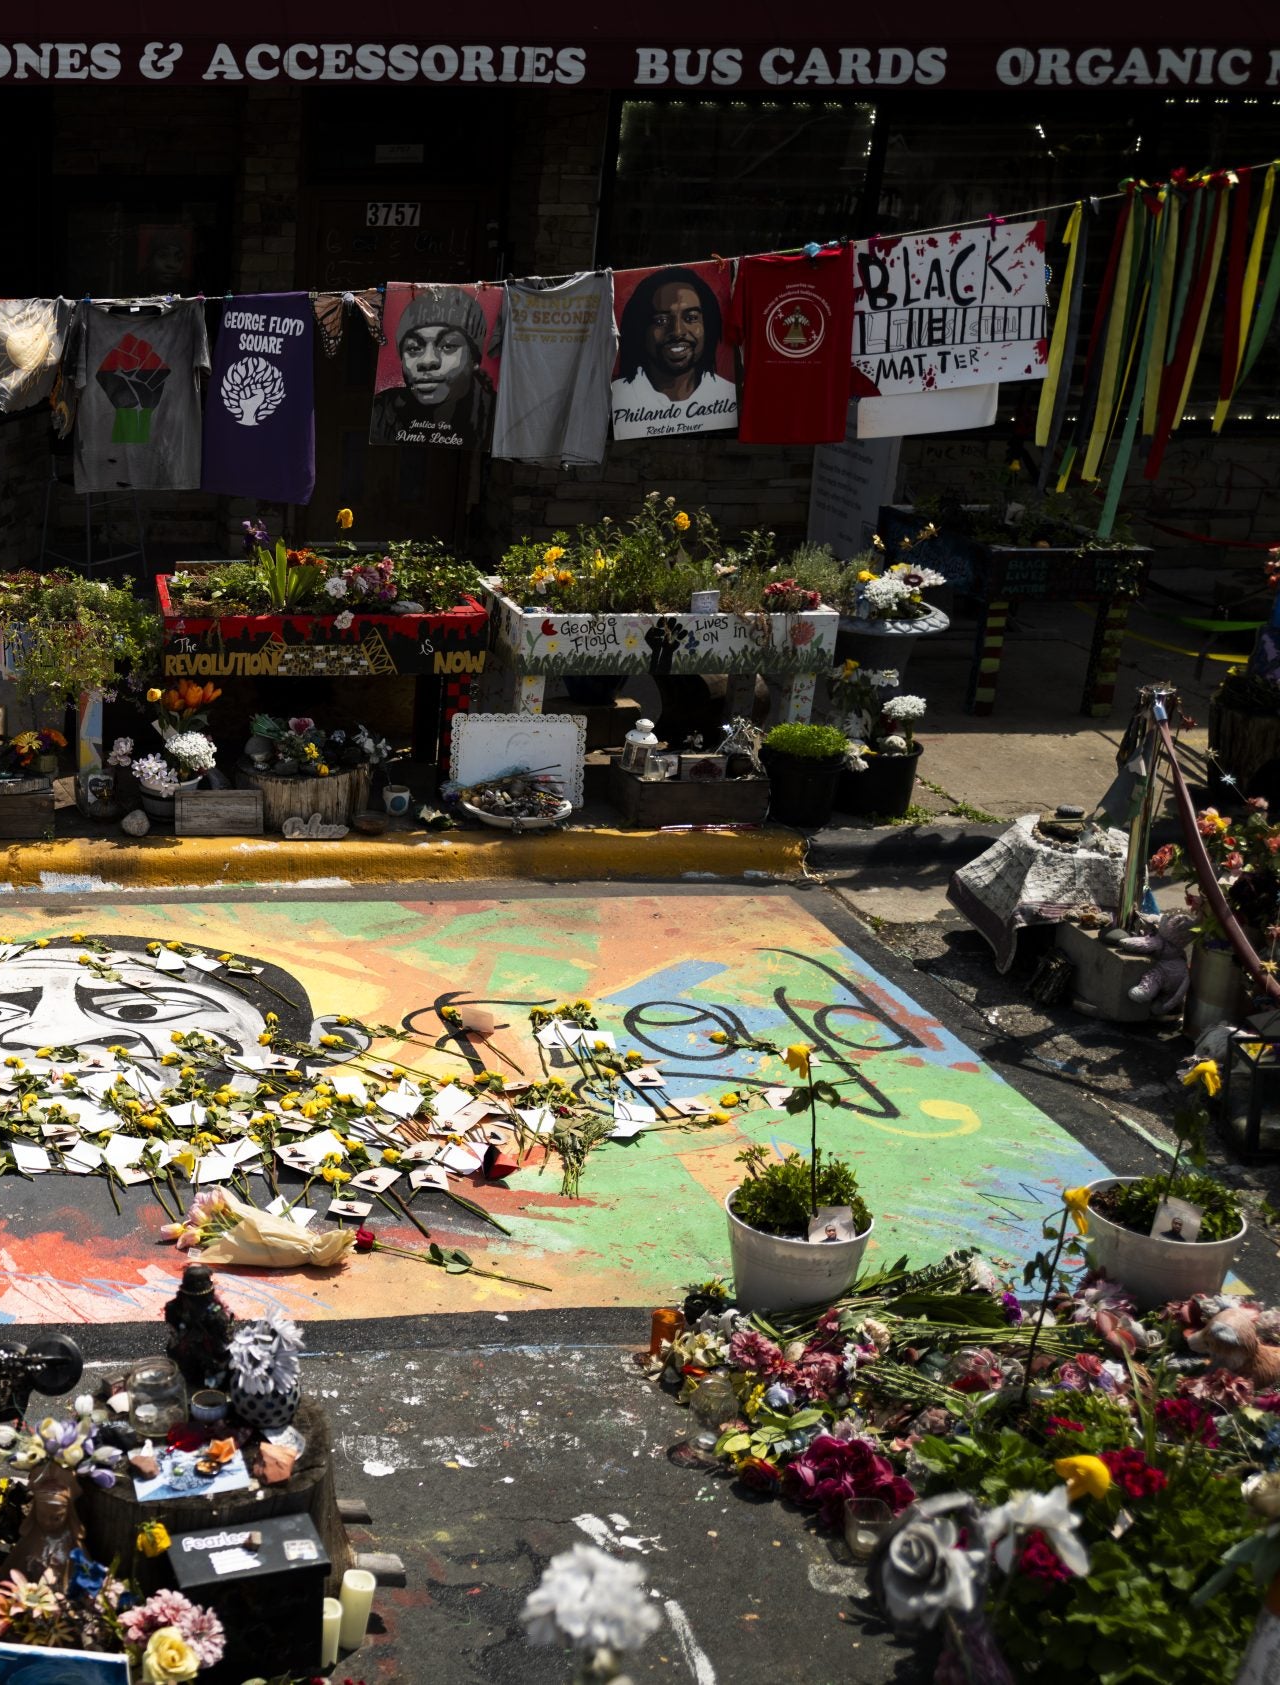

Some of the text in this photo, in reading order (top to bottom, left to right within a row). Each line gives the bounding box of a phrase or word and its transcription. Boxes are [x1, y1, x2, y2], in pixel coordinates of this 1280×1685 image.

[139, 41, 184, 79] &
[202, 42, 588, 84] ACCESSORIES
[634, 47, 744, 85] BUS
[759, 47, 948, 86] CARDS
[995, 47, 1252, 86] ORGANIC
[368, 203, 419, 226] 3757
[858, 239, 1013, 310] BLACK
[224, 310, 305, 338] GEORGE FLOYD
[532, 310, 598, 325] SECONDS
[238, 332, 284, 356] SQUARE
[875, 349, 980, 387] MATTER
[409, 419, 436, 429] Justice
[614, 399, 737, 425] Philando Castile
[395, 429, 463, 446] Amir Locke
[646, 422, 704, 436] Rest in Power
[695, 616, 729, 632] Lives
[174, 637, 198, 653] The
[571, 626, 620, 653] Floyd
[164, 651, 282, 677] REVOLUTION
[433, 650, 486, 675] NOW
[183, 1532, 250, 1552] Fearles
